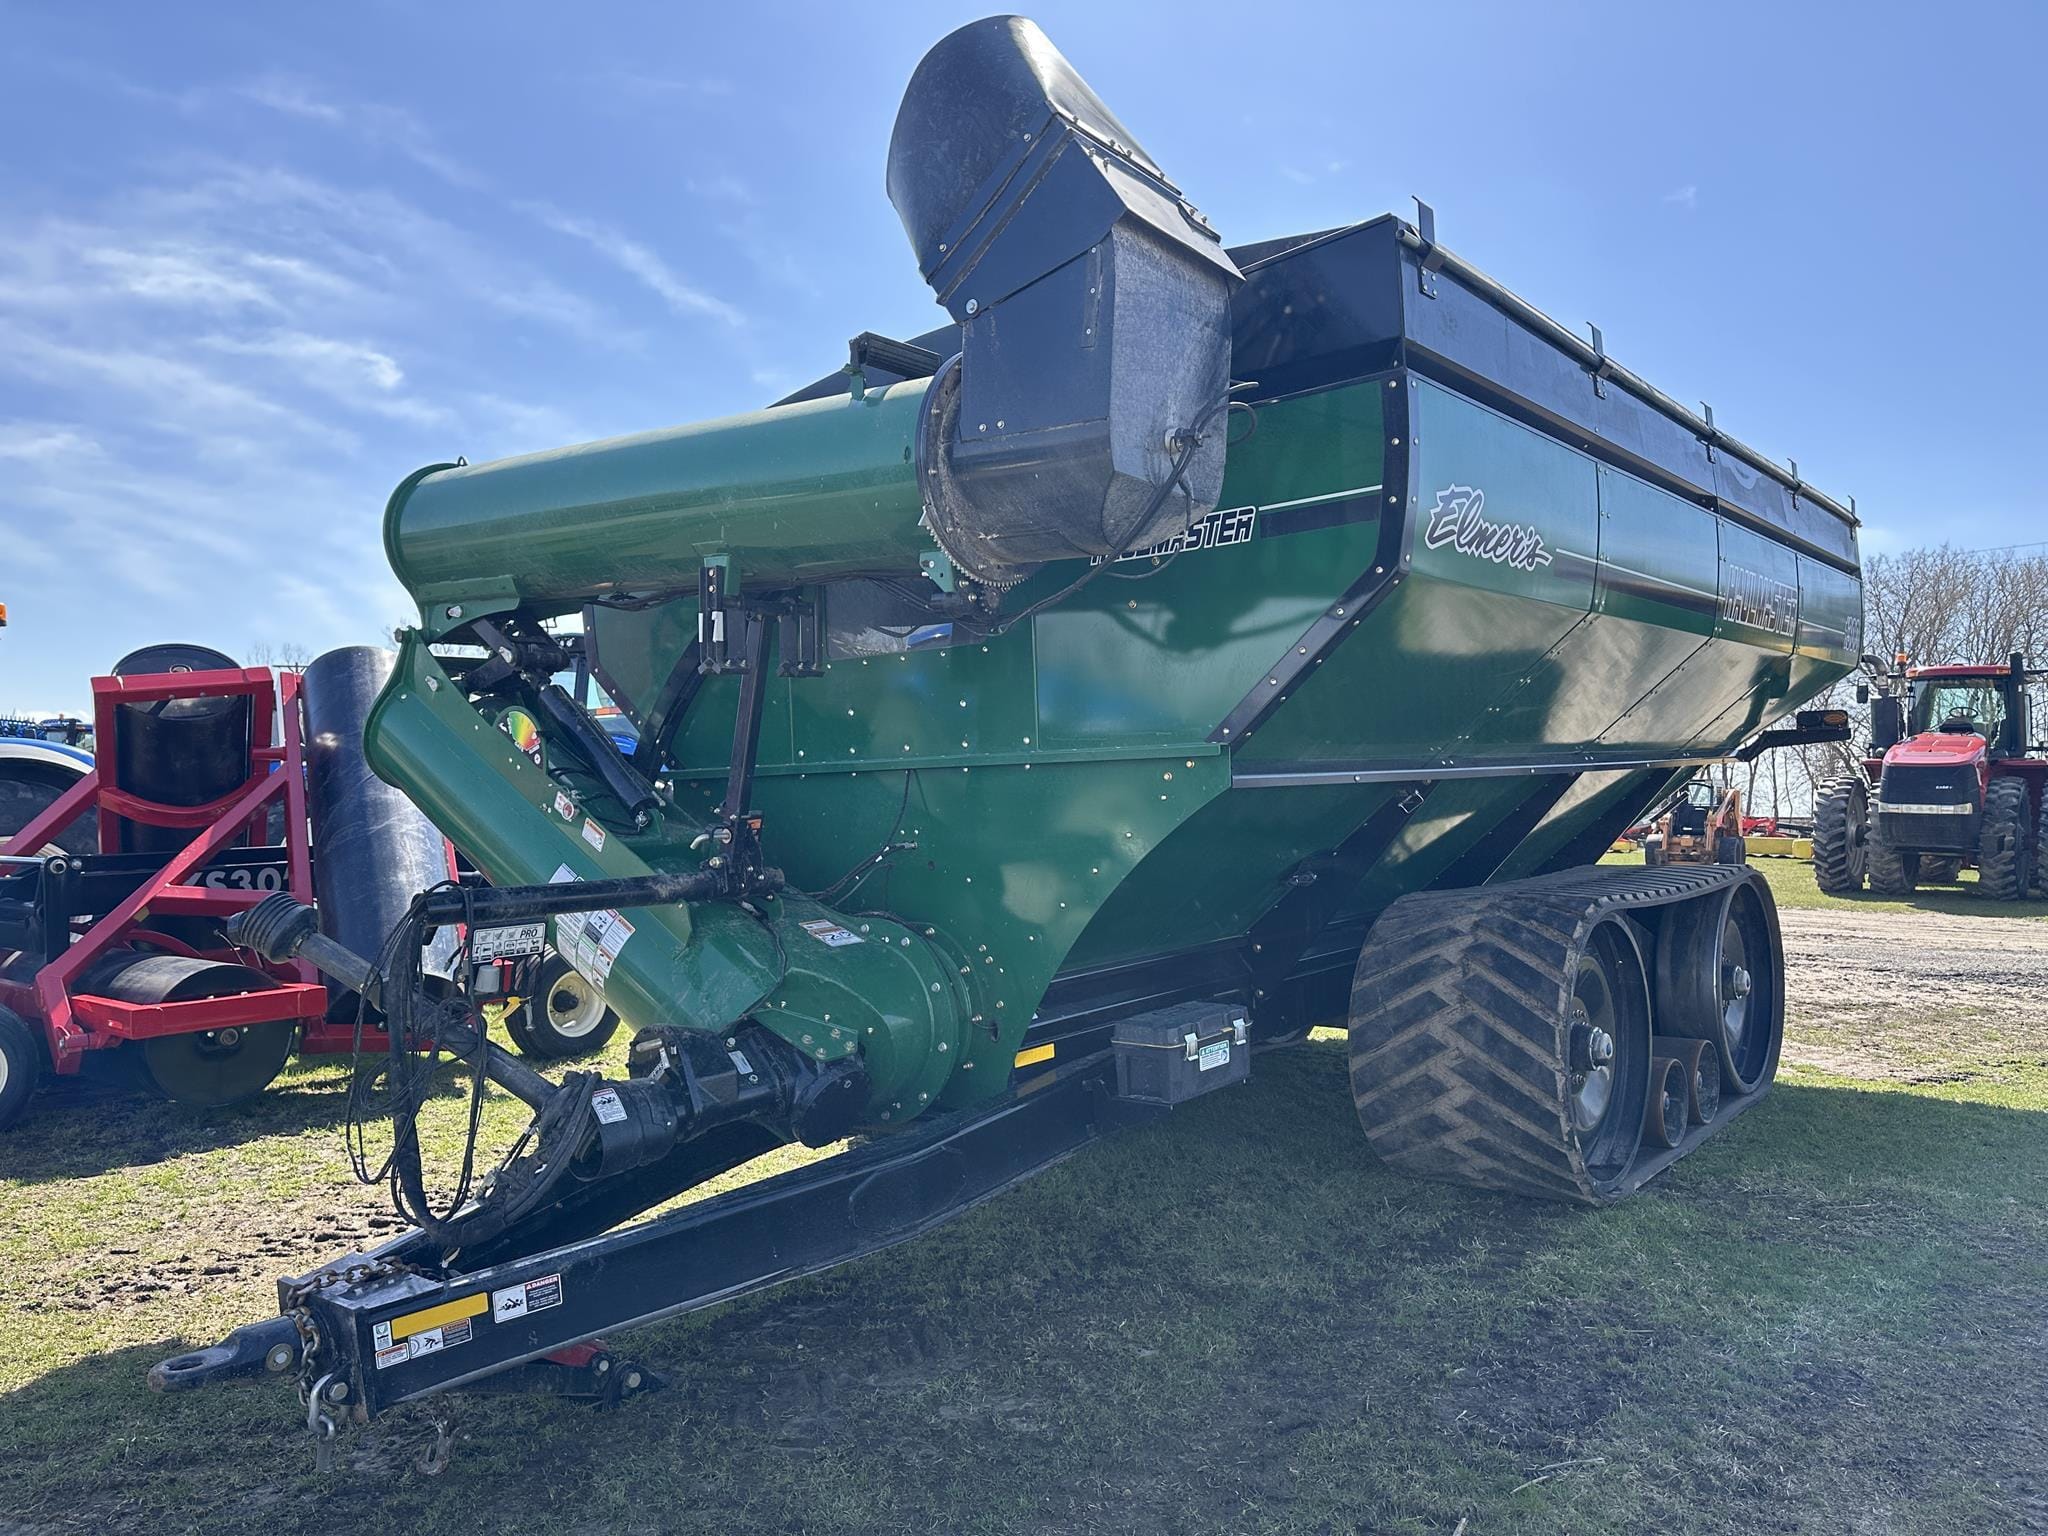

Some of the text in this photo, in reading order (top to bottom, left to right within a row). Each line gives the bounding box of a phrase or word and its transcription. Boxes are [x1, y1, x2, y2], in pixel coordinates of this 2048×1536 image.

[1425, 483, 1553, 571] Elmer's
[520, 928, 538, 938] PRO
[531, 1276, 558, 1288] DANGER
